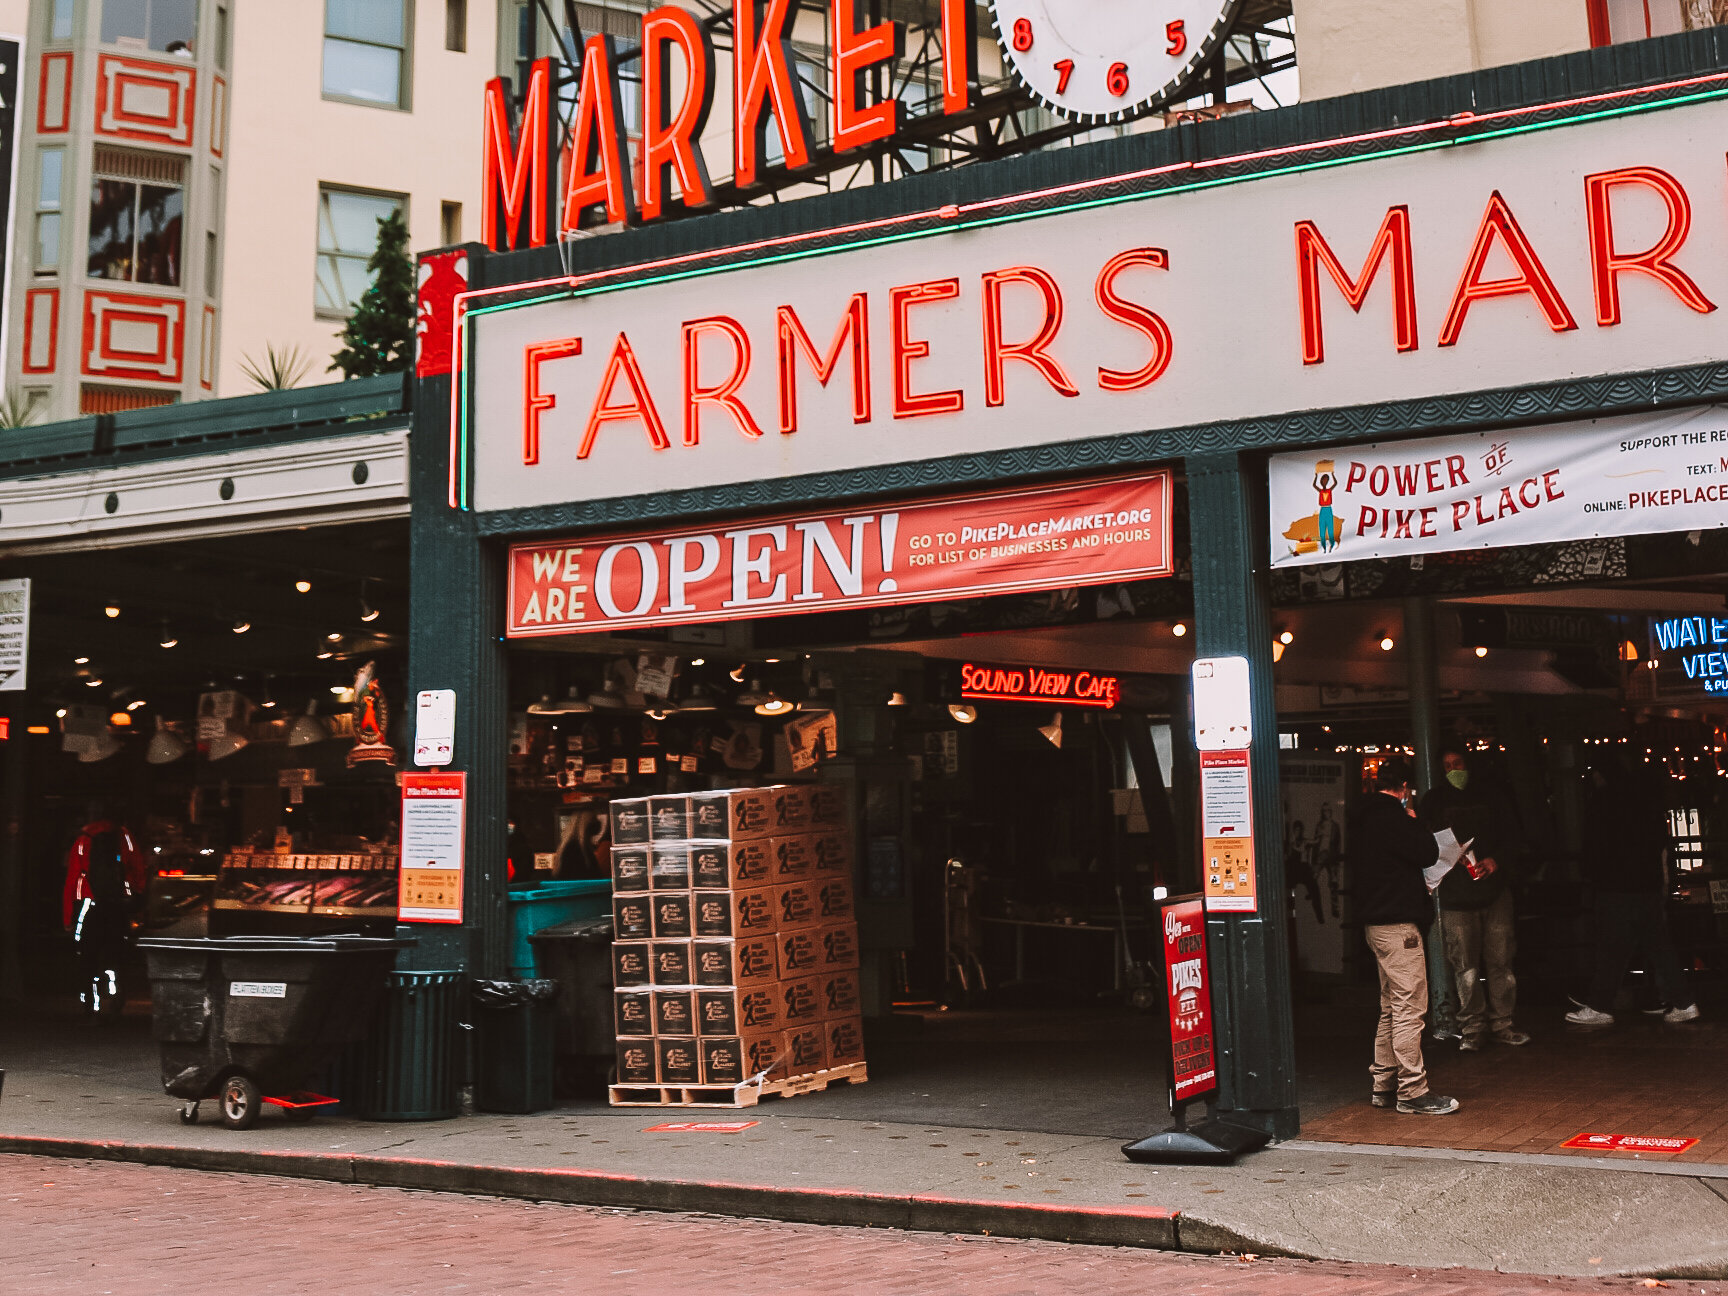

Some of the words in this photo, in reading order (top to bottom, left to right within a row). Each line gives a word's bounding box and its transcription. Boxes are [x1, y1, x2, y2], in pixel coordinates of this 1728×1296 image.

[1013, 18, 1034, 52] 8
[1165, 19, 1187, 56] 5
[1054, 59, 1075, 95] 7
[1107, 62, 1129, 97] 6
[521, 247, 1174, 466] FARMERS
[1294, 152, 1728, 365] MAR
[1620, 435, 1678, 452] SUPPORT
[1682, 432, 1707, 445] THE
[1710, 430, 1728, 443] RE
[1345, 454, 1470, 496] POWER
[1484, 444, 1509, 473] OF
[1686, 464, 1717, 476] TEXT:
[1356, 504, 1438, 540] PIKE
[1452, 469, 1566, 531] PLACE
[1584, 500, 1627, 513] ONLINE:
[1629, 484, 1728, 509] PIKEPLACE
[909, 534, 932, 549] GO
[936, 532, 957, 546] TO
[909, 551, 934, 567] FOR
[938, 549, 965, 563] LIST
[969, 547, 987, 561] OF
[990, 538, 1068, 559] BUSINESSES
[1072, 534, 1100, 549] AND
[1104, 529, 1151, 545] HOURS
[533, 548, 582, 583] WE
[593, 512, 900, 619] OPEN!
[521, 585, 588, 624] ARE
[961, 663, 1024, 693] SOUND
[1029, 668, 1071, 695] VIEW
[1075, 671, 1117, 698] CAFE
[1704, 680, 1713, 692] &
[1165, 912, 1182, 944] Yes
[1171, 959, 1202, 996] PIKES
